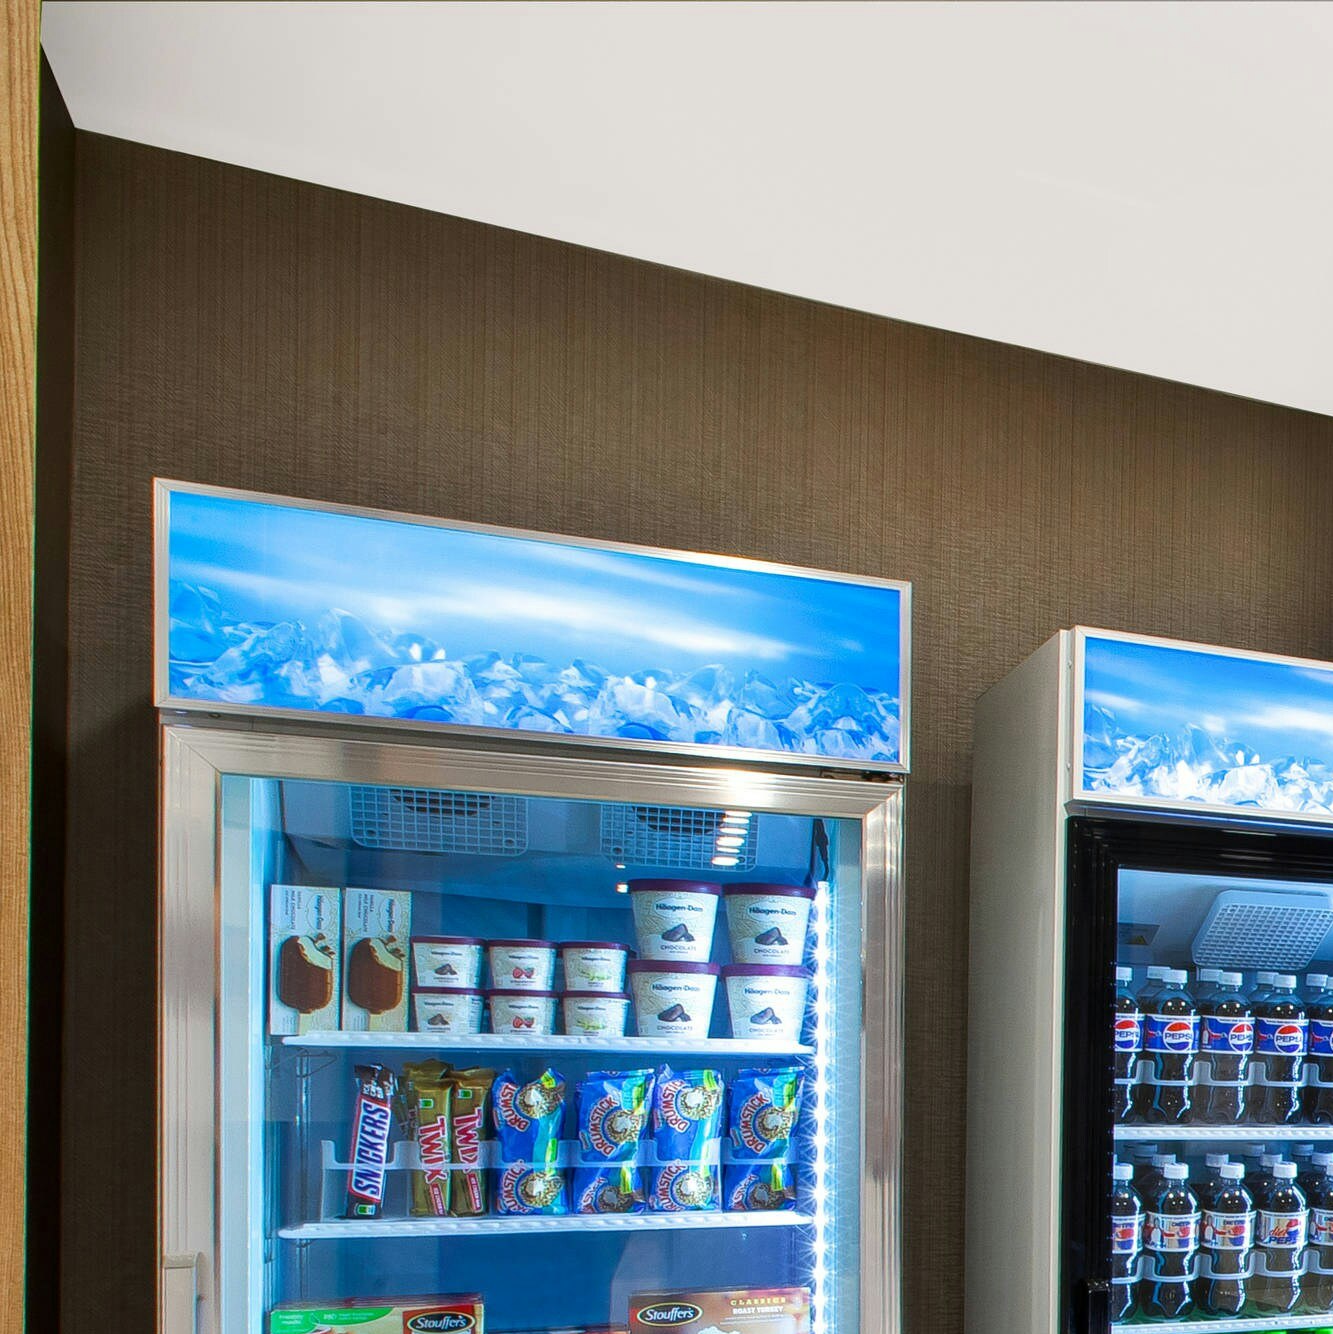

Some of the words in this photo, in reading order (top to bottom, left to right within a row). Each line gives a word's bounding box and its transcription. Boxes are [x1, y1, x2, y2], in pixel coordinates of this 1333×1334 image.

[660, 944, 697, 952] CHOCOLATE
[753, 947, 790, 955] CHOCOLATE
[588, 1094, 621, 1157] DRUMSTICK
[739, 1091, 770, 1154] DRUMSTICK
[353, 1101, 390, 1198] SNICKERS
[418, 1115, 448, 1185] TWIX
[415, 1313, 468, 1331] Stouffer's
[645, 1306, 695, 1322] Stouffer's
